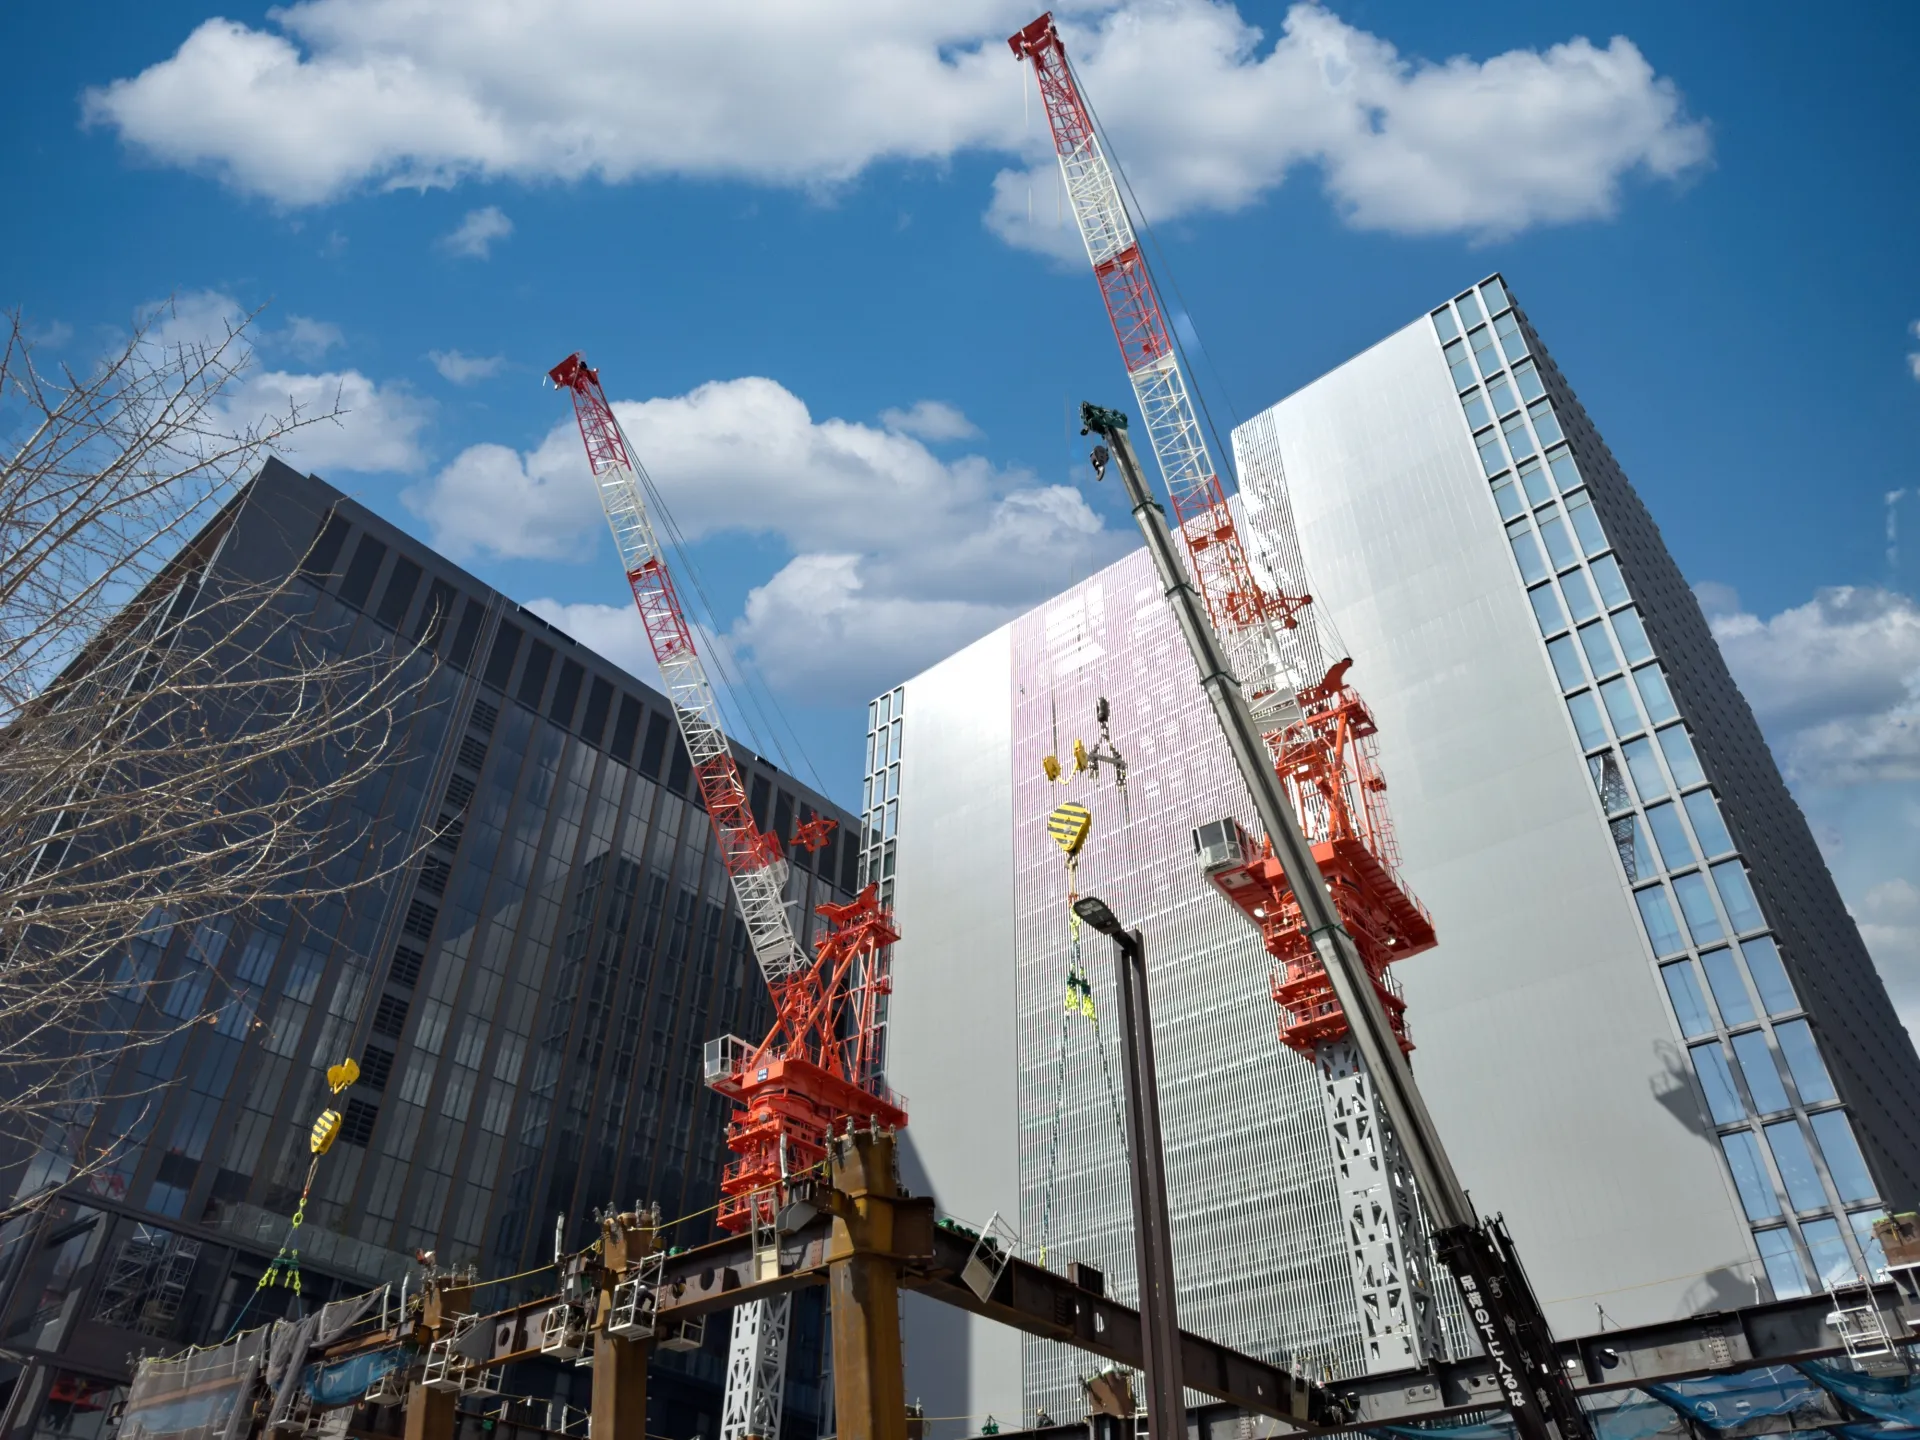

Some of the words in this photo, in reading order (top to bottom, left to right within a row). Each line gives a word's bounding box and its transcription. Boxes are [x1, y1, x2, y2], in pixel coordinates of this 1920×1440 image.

[1460, 1274, 1526, 1408] 吊荷の下に入るな
